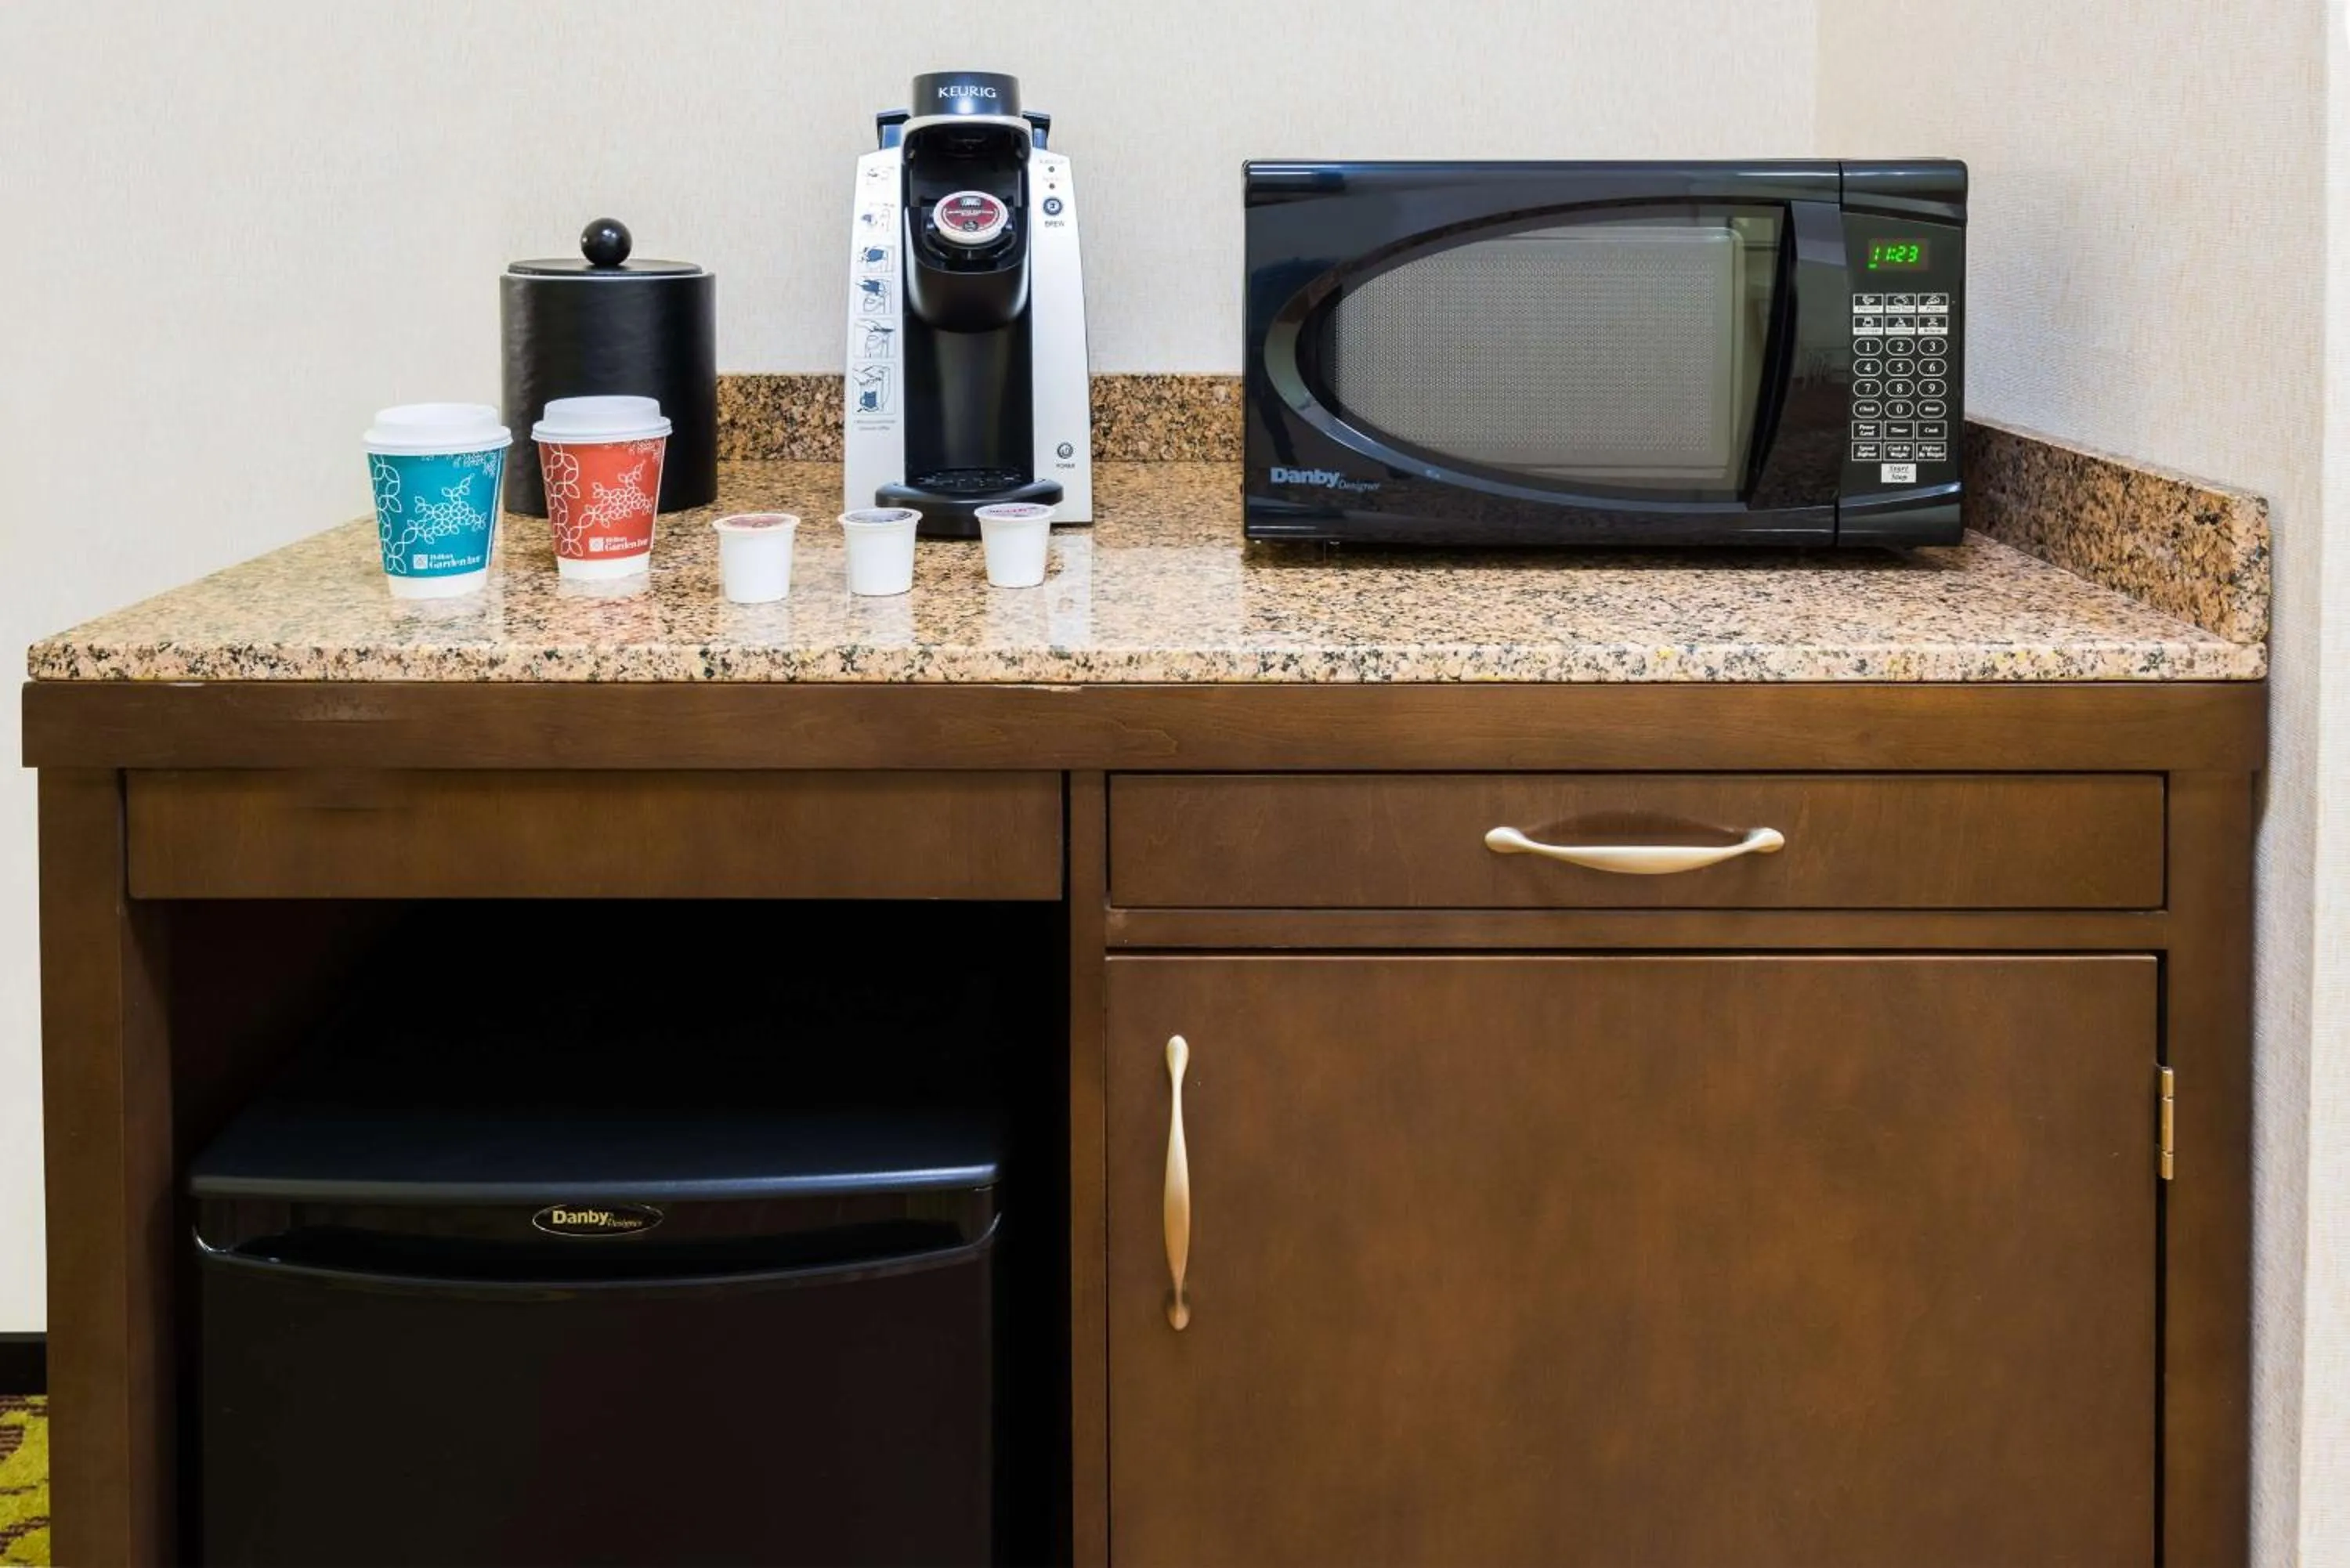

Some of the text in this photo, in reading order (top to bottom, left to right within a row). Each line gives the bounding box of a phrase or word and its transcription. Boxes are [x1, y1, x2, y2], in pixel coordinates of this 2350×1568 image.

[938, 85, 997, 99] KEURIG
[1875, 245, 1919, 263] 11:23
[1866, 341, 1871, 352] 1
[1896, 341, 1904, 352] 2
[1929, 341, 1936, 352] 3
[1864, 362, 1871, 373] 4
[1896, 362, 1904, 372] 5
[1929, 362, 1936, 372] 6
[1864, 383, 1871, 393] 7
[1896, 383, 1904, 394] 8
[1928, 383, 1936, 394] 9
[1896, 403, 1904, 414] 0
[1270, 467, 1341, 489] Danby
[551, 1209, 609, 1227] Danby
